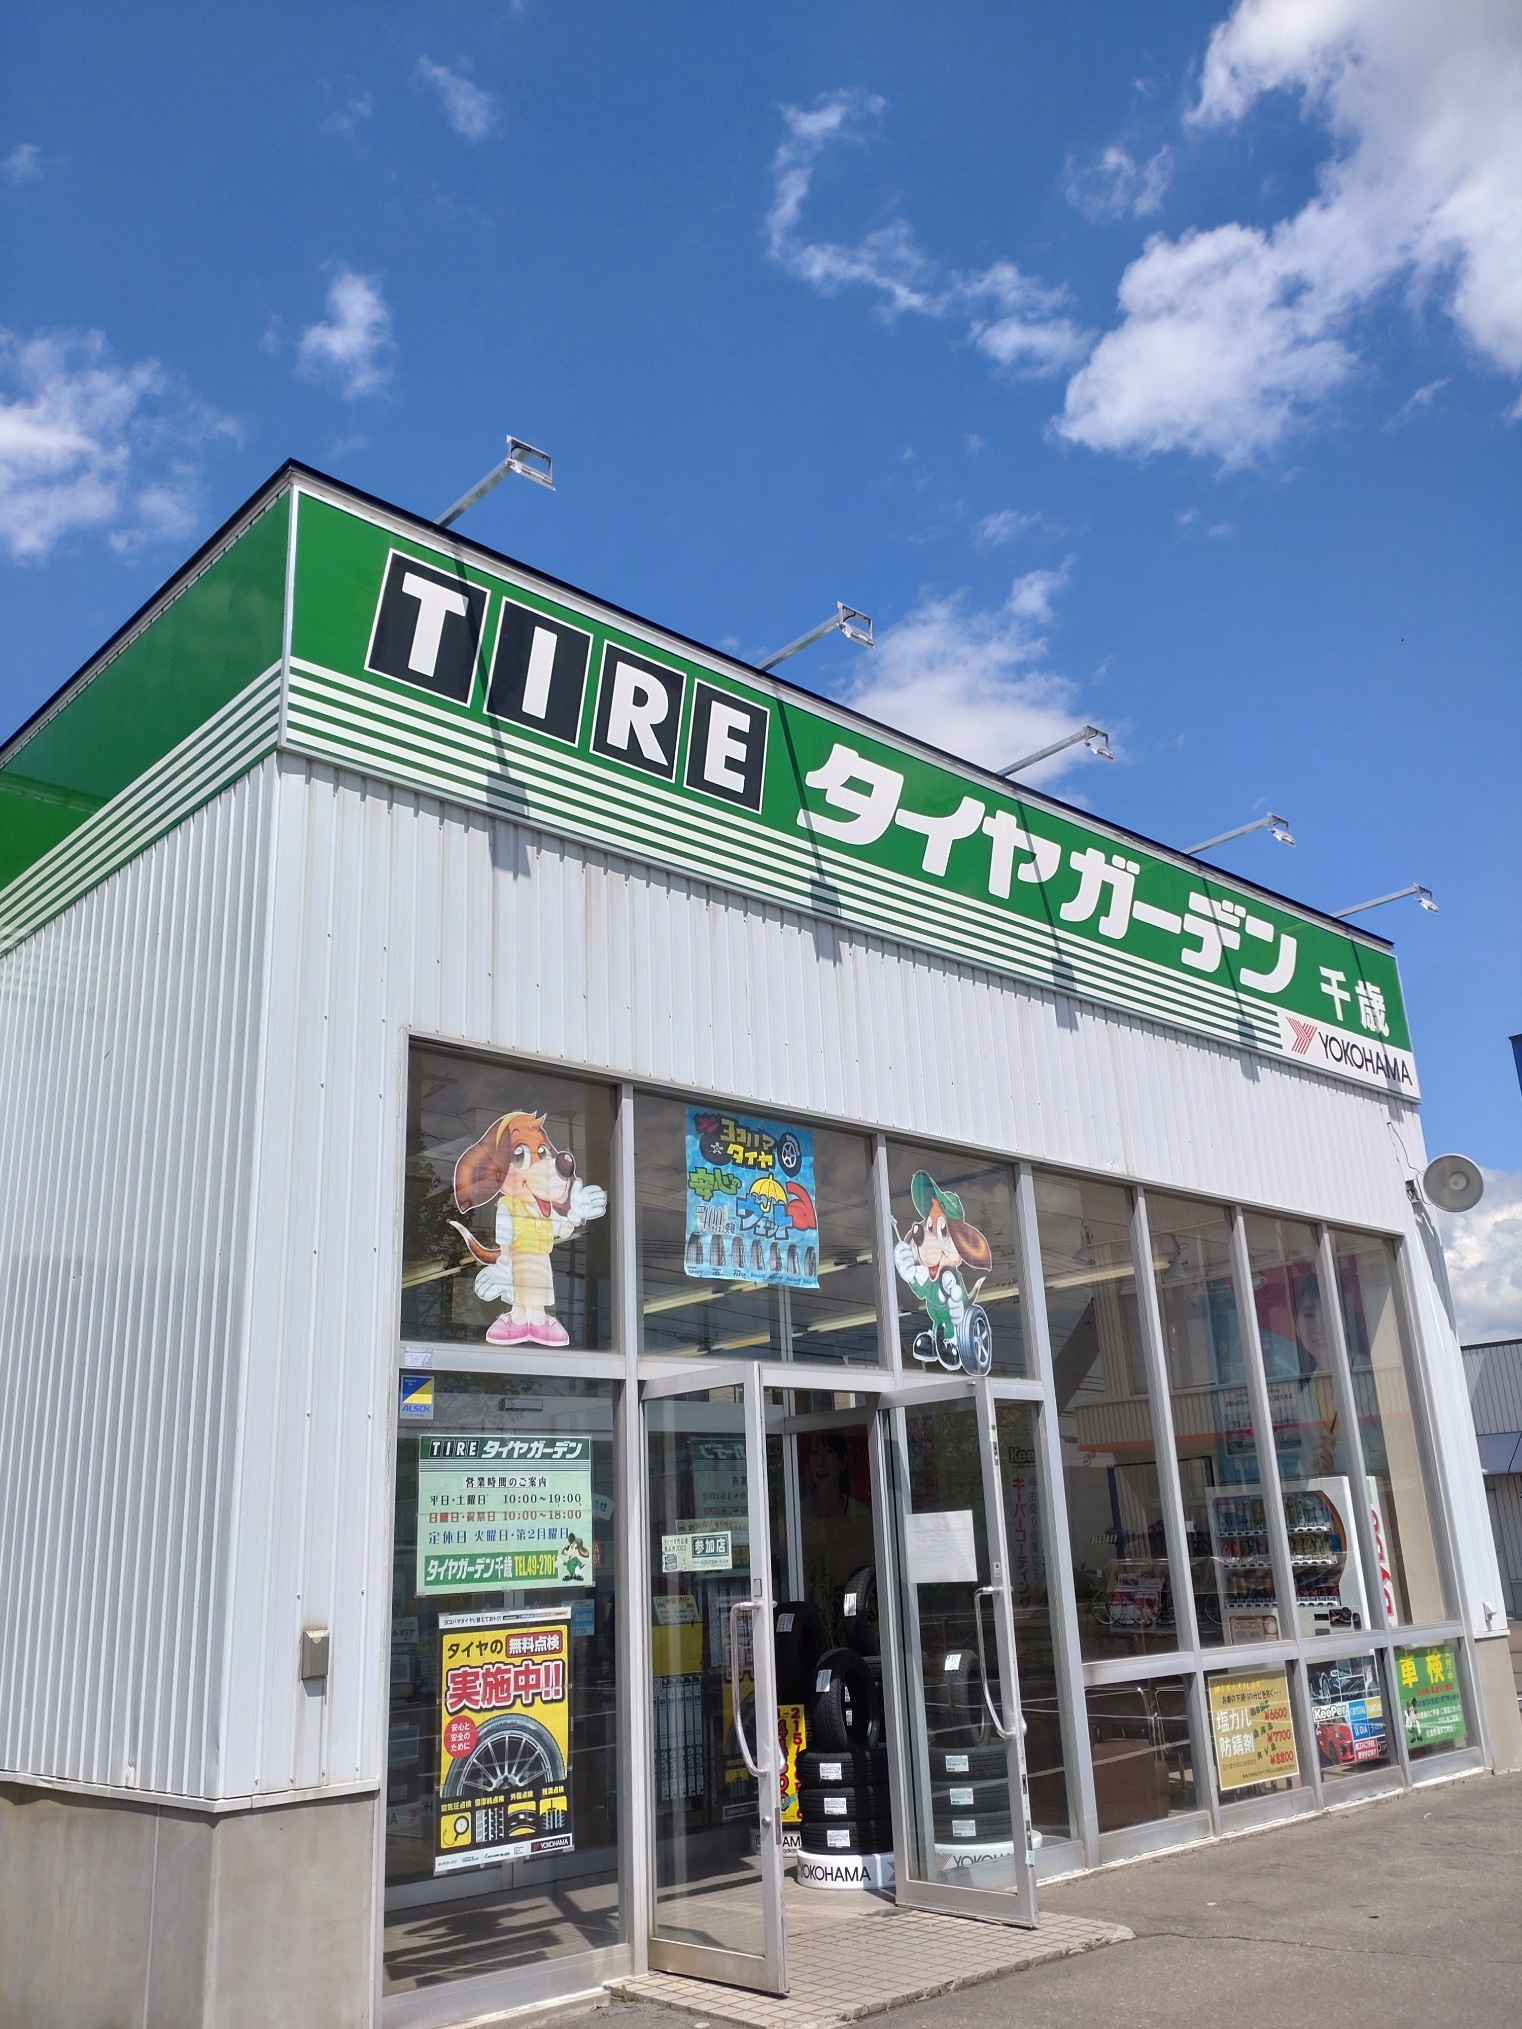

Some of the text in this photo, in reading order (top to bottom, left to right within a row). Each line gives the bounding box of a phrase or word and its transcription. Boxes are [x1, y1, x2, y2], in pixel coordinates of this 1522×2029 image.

[401, 571, 751, 794] TIRE
[797, 743, 1390, 1037] タイヤガーデン 千歳
[1317, 1033, 1414, 1087] YOKOHAMA
[727, 1143, 773, 1169] タイヤ
[431, 1440, 583, 1459] TIRE タイヤガーデン
[1009, 1447, 1035, 1464] Kee
[465, 1476, 548, 1488] 営業時間のご案内
[429, 1494, 486, 1506] 平日・土曜日
[428, 1511, 496, 1523] 日曜日・祝祭日
[428, 1527, 569, 1545] 定休日 火曜日・第2月曜日
[694, 1538, 726, 1555] 参加店
[426, 1555, 513, 1582] タイヤガーデン千歳
[447, 1634, 561, 1660] タイヤの 無料点検
[1399, 1650, 1446, 1689] 車検
[446, 1661, 564, 1711] 実施中!!
[1216, 1707, 1252, 1732] 塩カル
[1313, 1704, 1347, 1720] KeePer
[451, 1722, 471, 1732] 安心と
[450, 1732, 471, 1742] 安全の
[450, 1742, 471, 1752] ために
[540, 1838, 569, 1850] YOKOHAMA
[799, 1864, 871, 1882] YOKOHAMA
